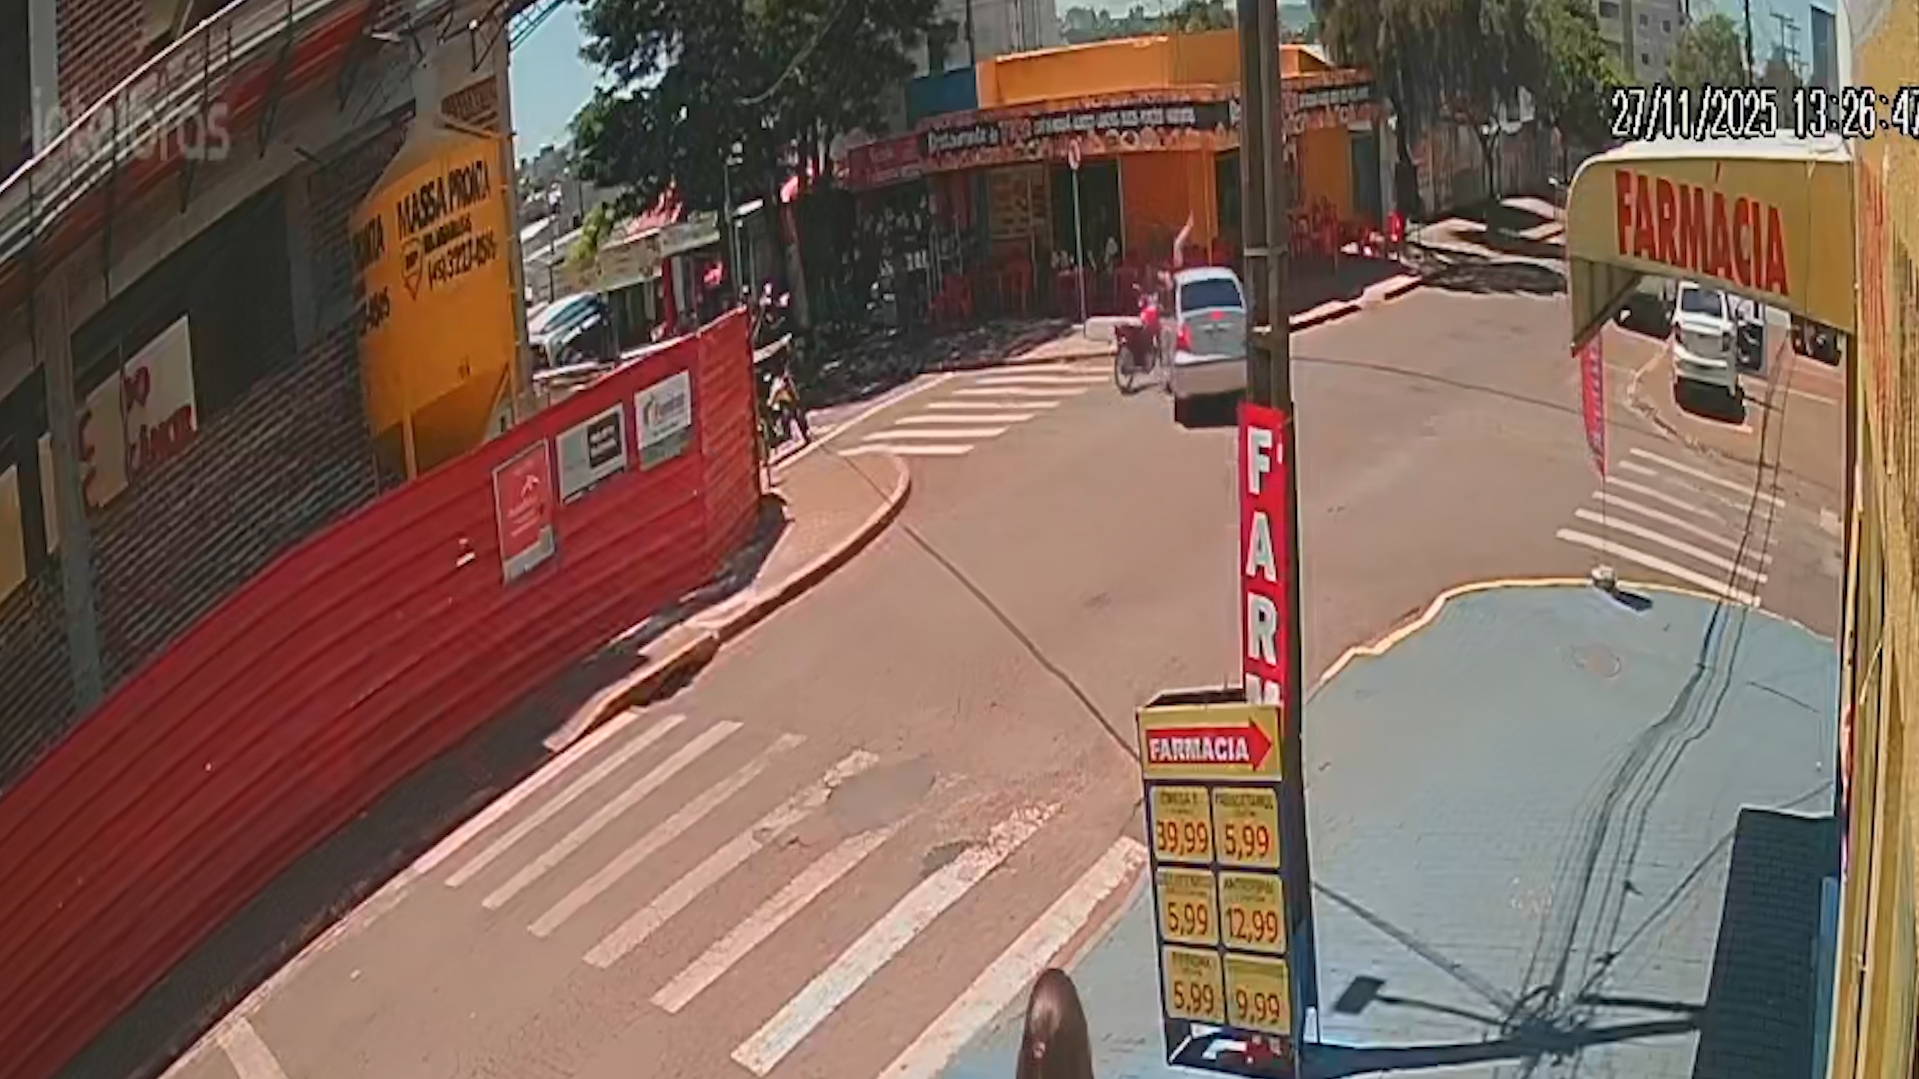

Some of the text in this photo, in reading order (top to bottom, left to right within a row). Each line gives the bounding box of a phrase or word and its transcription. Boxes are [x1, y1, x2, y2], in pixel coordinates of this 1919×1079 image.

[397, 176, 448, 241] MASSA
[449, 160, 492, 213] PRONTA
[1615, 161, 1791, 296] FARMÁCIA
[1149, 735, 1250, 762] FARMACIA
[1157, 819, 1208, 857] 39,99
[1225, 822, 1270, 861] 5,99
[1167, 901, 1208, 936] 5,99
[1225, 907, 1278, 944] 12,99
[1173, 980, 1214, 1015] 5,99
[1235, 988, 1281, 1025] 9,99
